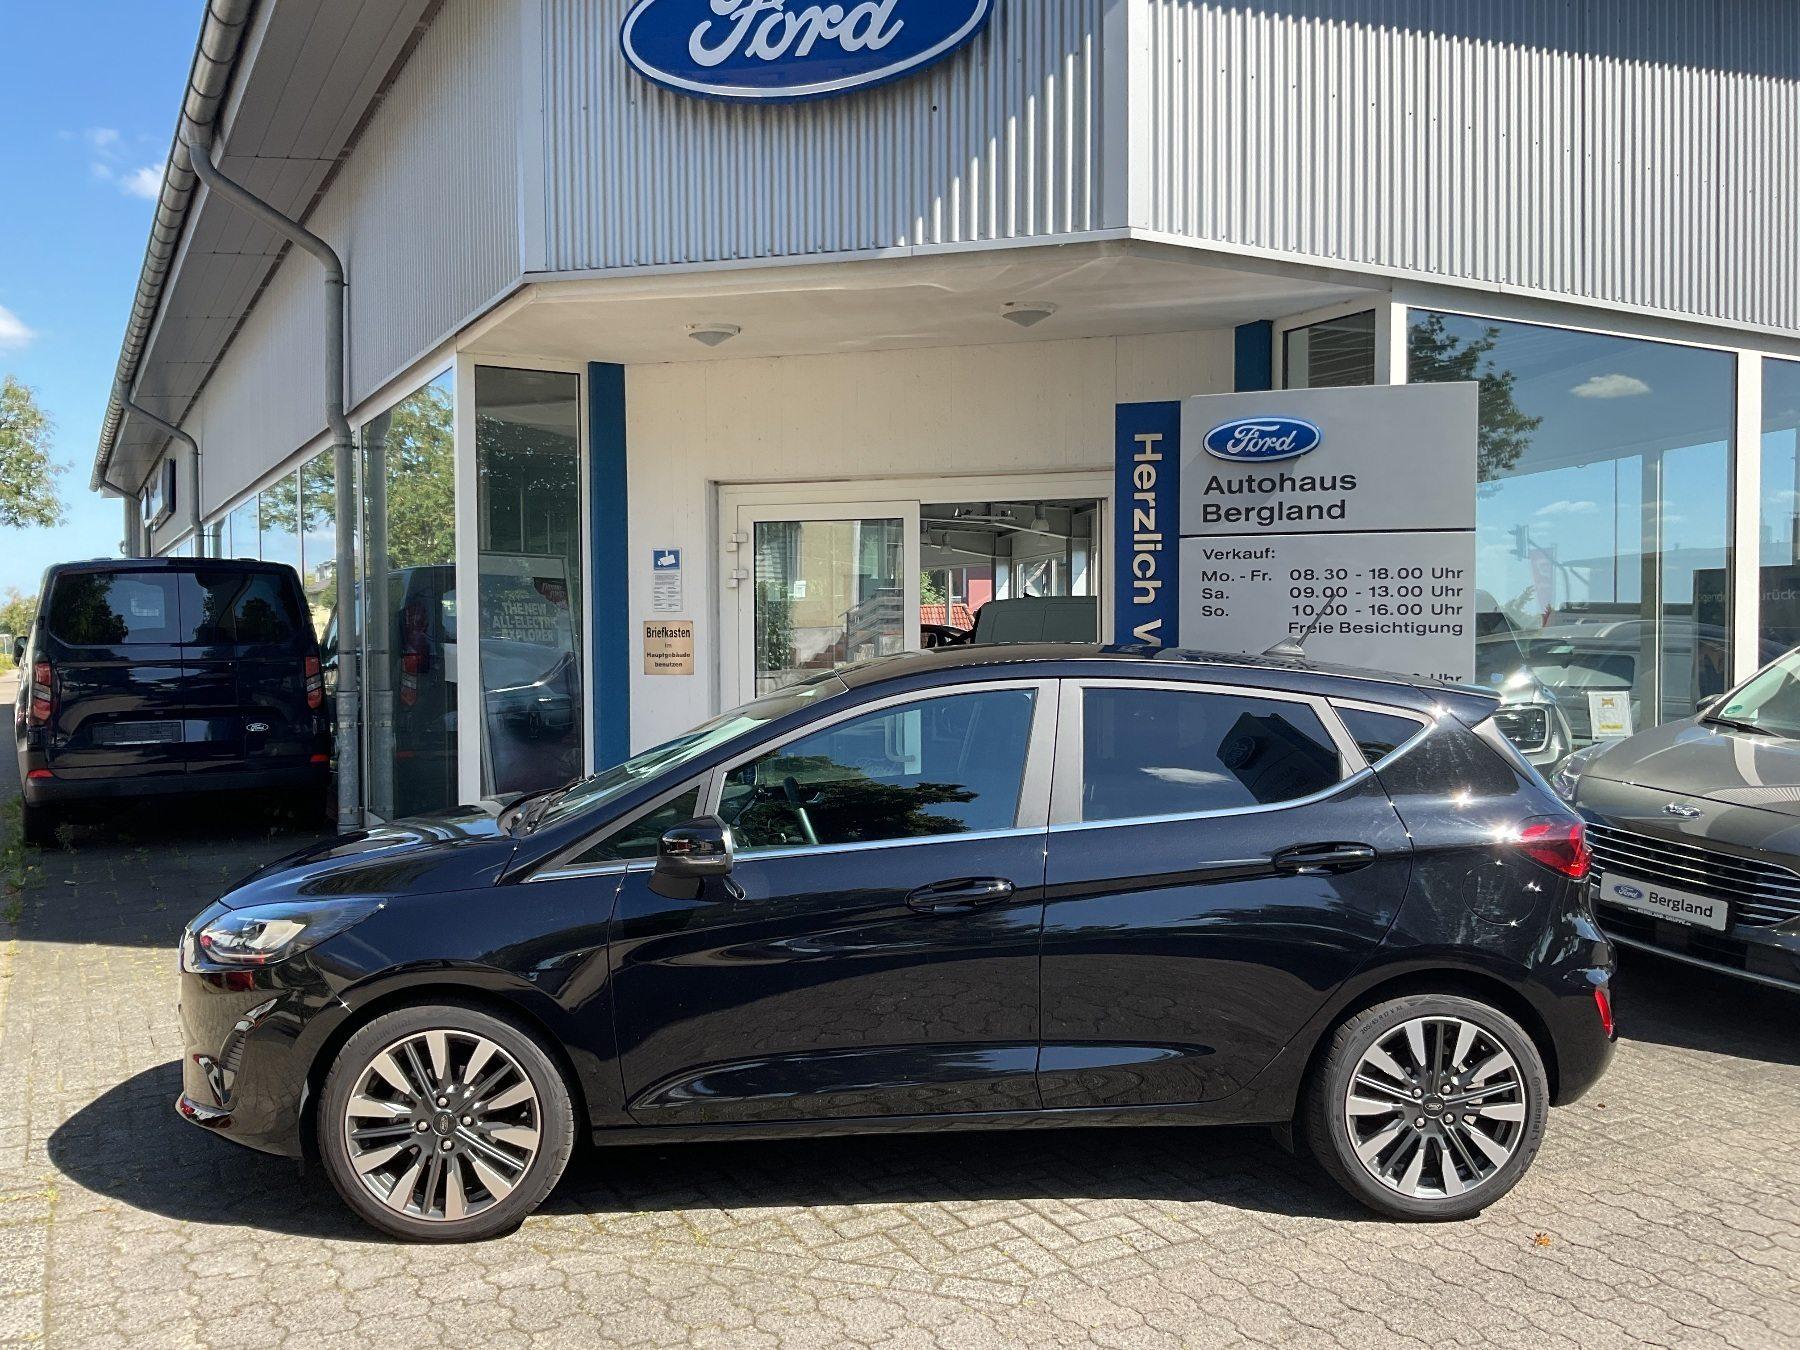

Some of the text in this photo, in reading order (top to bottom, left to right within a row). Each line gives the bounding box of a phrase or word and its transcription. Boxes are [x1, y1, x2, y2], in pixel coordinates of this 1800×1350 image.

[689, 0, 905, 67] Ford
[1226, 425, 1298, 454] Ford
[1203, 473, 1357, 495] Autohaus
[1133, 433, 1162, 603] Herzlich
[1202, 499, 1346, 526] Bergland
[1203, 548, 1275, 560] Verkauf:
[1201, 570, 1235, 582] Mo.
[1250, 570, 1272, 581] Fr.
[1289, 568, 1348, 581] 08.30
[1368, 567, 1423, 580] 18.00
[1431, 567, 1463, 579] Uhr
[1201, 588, 1230, 600] Sa.
[1289, 586, 1348, 599] 09.00
[1368, 585, 1423, 598] 13.00
[1431, 585, 1463, 598] Uhr
[1201, 605, 1229, 617] So.
[1291, 604, 1348, 616] 10.00
[1368, 603, 1423, 616] 16.00
[1431, 603, 1463, 616] Uhr
[646, 626, 691, 639] Briefkasten
[1288, 621, 1463, 637] Freie Besichtigung
[646, 651, 691, 659] Hauptgebäude
[1618, 886, 1639, 898] Ford
[1648, 891, 1713, 918] Bergland
